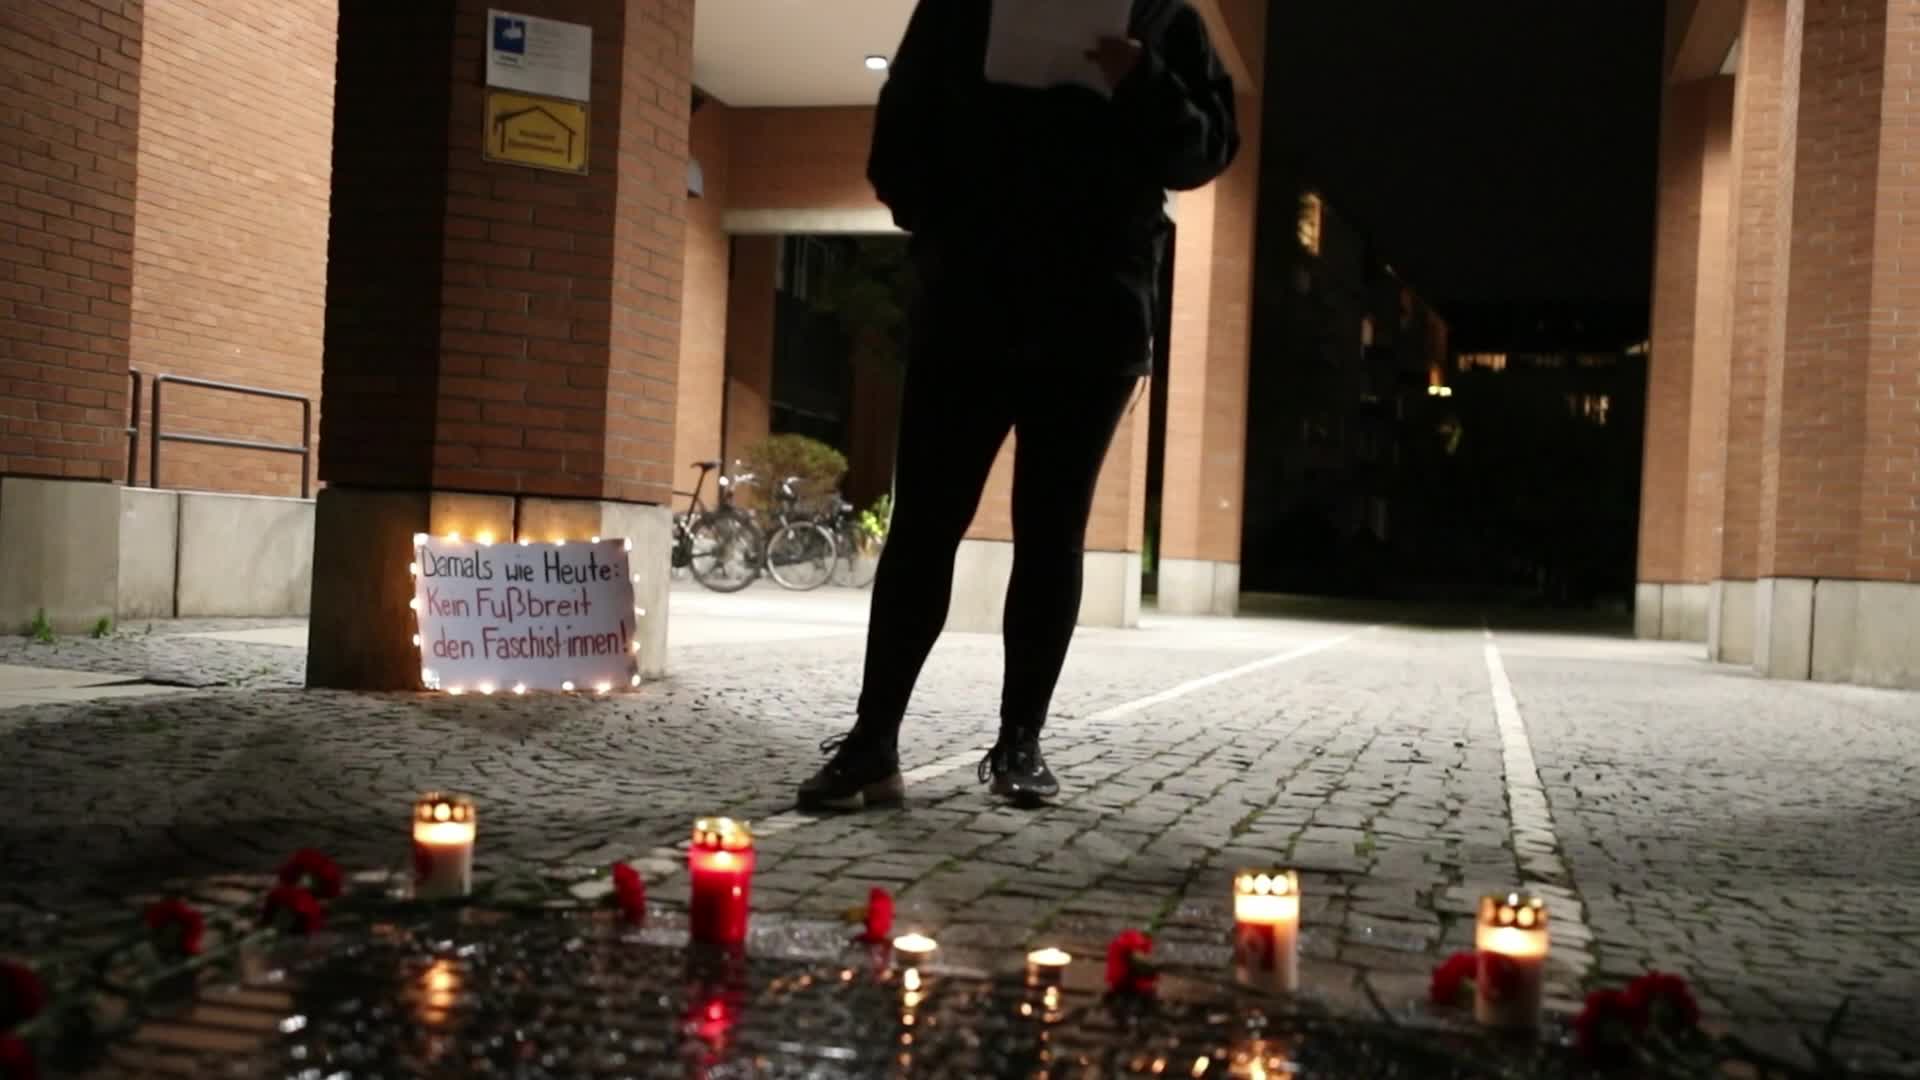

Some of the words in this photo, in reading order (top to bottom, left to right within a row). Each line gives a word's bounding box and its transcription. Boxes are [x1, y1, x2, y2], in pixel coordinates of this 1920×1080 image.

[422, 548, 494, 581] Damals
[505, 555, 534, 582] wie
[544, 551, 620, 584] Heute:
[426, 586, 470, 616] Kein
[476, 586, 593, 622] Fußbreit
[433, 625, 474, 660] den
